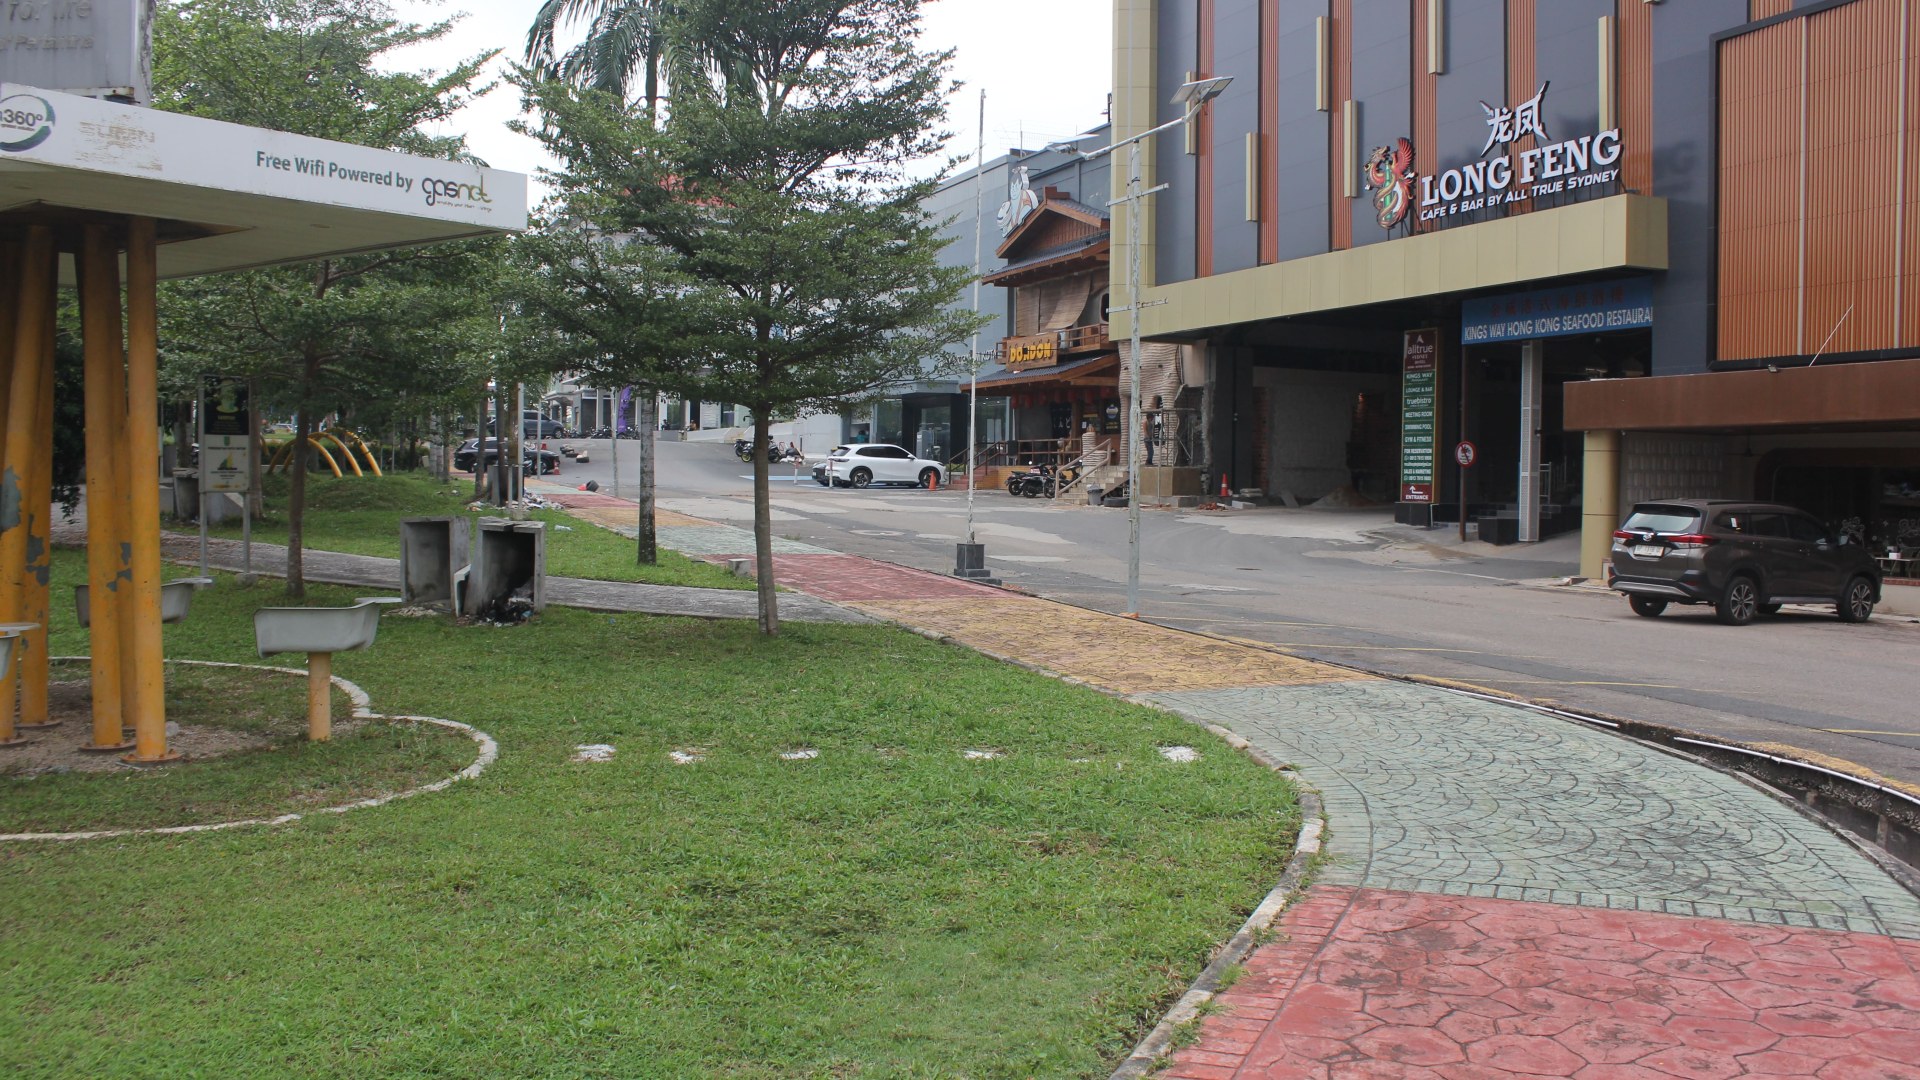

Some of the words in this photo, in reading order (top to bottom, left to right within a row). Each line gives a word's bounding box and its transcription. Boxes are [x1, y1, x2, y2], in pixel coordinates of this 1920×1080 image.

[1480, 80, 1551, 157] 龙凤
[256, 150, 291, 171] Free
[295, 157, 325, 177] Wifi
[328, 162, 392, 187] Powered
[396, 172, 413, 193] by
[1421, 155, 1512, 207] LONG
[1520, 128, 1621, 184] FENG
[422, 174, 492, 207] gasnet
[1420, 206, 1447, 221] CAFE
[1449, 203, 1458, 215] &
[1460, 198, 1483, 213] BAR
[1487, 194, 1503, 207] BY
[1504, 188, 1528, 203] ALL
[1531, 180, 1564, 197] TRUE
[1567, 168, 1619, 190] SYDNEY
[1464, 324, 1488, 340] KINGS
[1489, 322, 1506, 338] WAY
[1507, 319, 1533, 336] HONG
[1535, 317, 1560, 333] KONG
[1562, 312, 1604, 331] SEAFOOD
[1407, 345, 1433, 355] alltrue
[1406, 397, 1432, 405] truebistro
